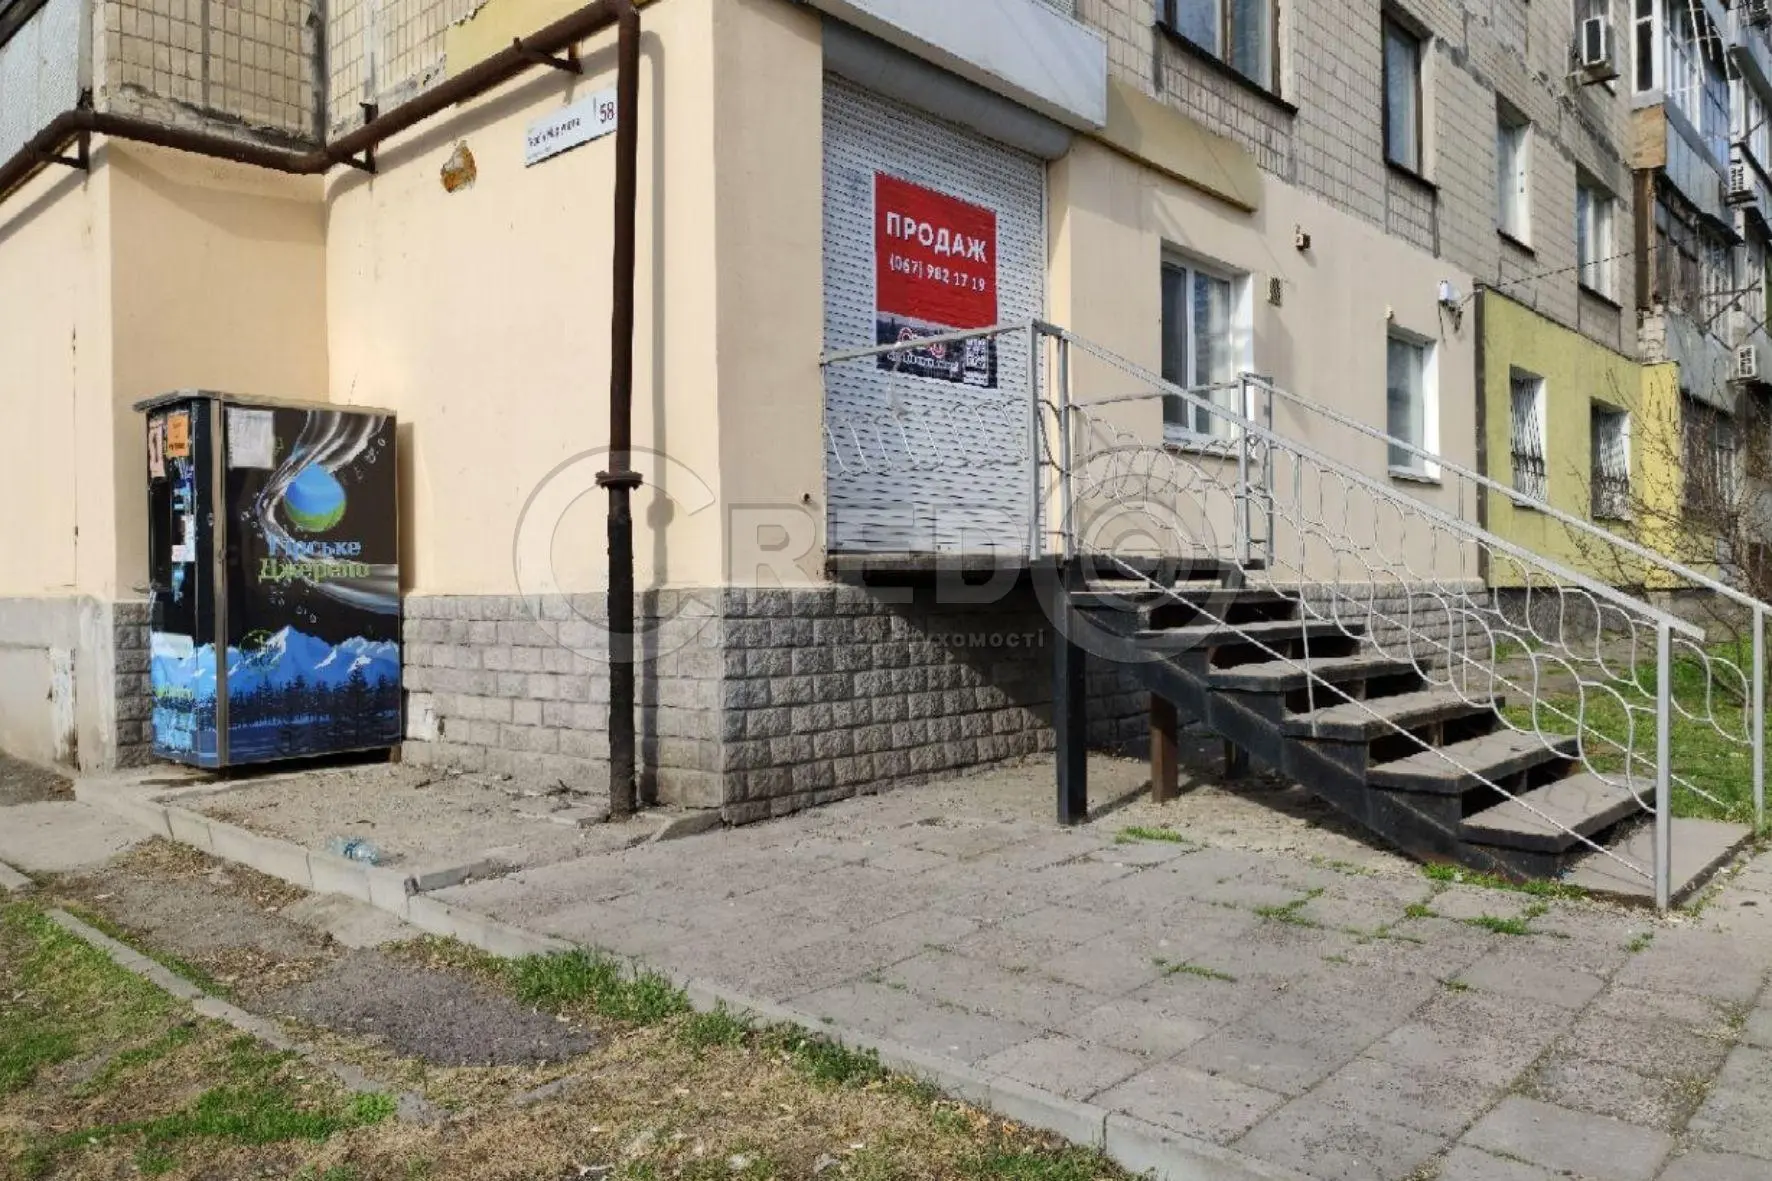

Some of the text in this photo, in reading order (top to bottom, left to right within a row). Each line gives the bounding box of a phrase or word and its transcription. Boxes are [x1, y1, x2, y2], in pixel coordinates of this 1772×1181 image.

[599, 101, 616, 125] 58
[886, 211, 988, 263] ПРОДАЖ
[889, 252, 923, 279] (067)
[953, 272, 968, 287] 17
[971, 277, 986, 292] 19
